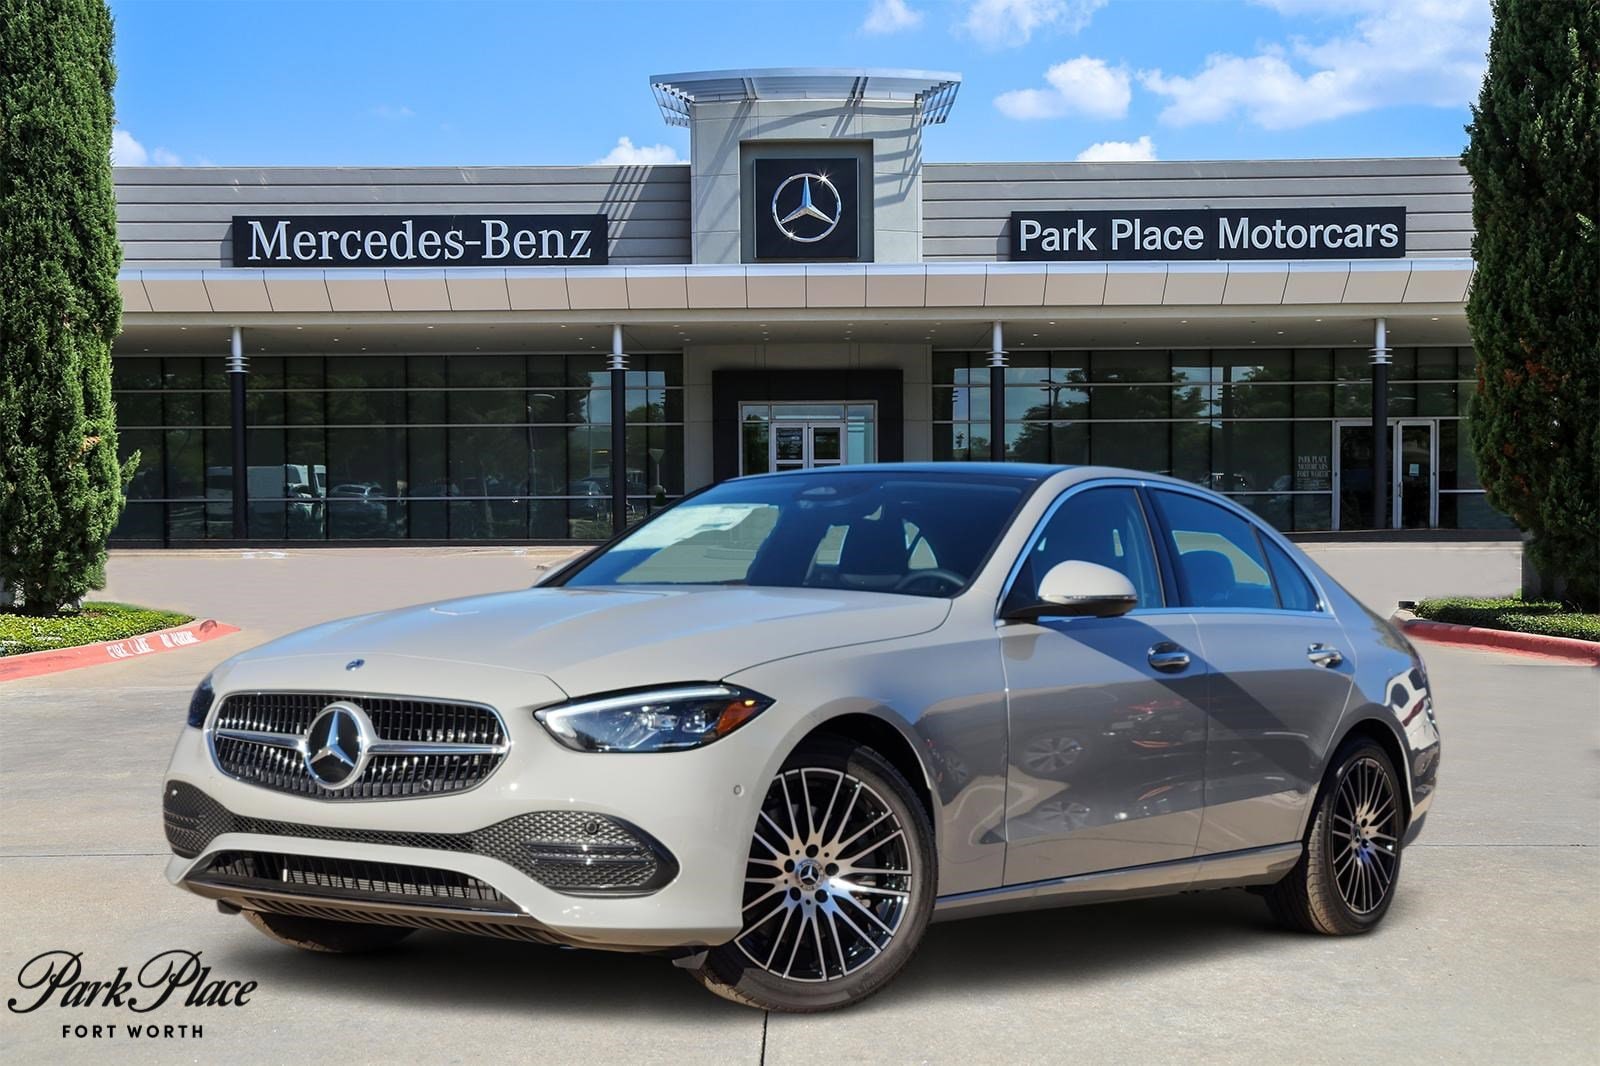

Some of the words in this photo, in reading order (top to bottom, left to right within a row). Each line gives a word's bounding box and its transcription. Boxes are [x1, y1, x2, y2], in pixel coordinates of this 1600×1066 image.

[248, 219, 592, 261] Mercedes-Benz
[1019, 219, 1098, 251] Park
[1111, 218, 1204, 250] Place
[1218, 217, 1399, 249] Motorcars
